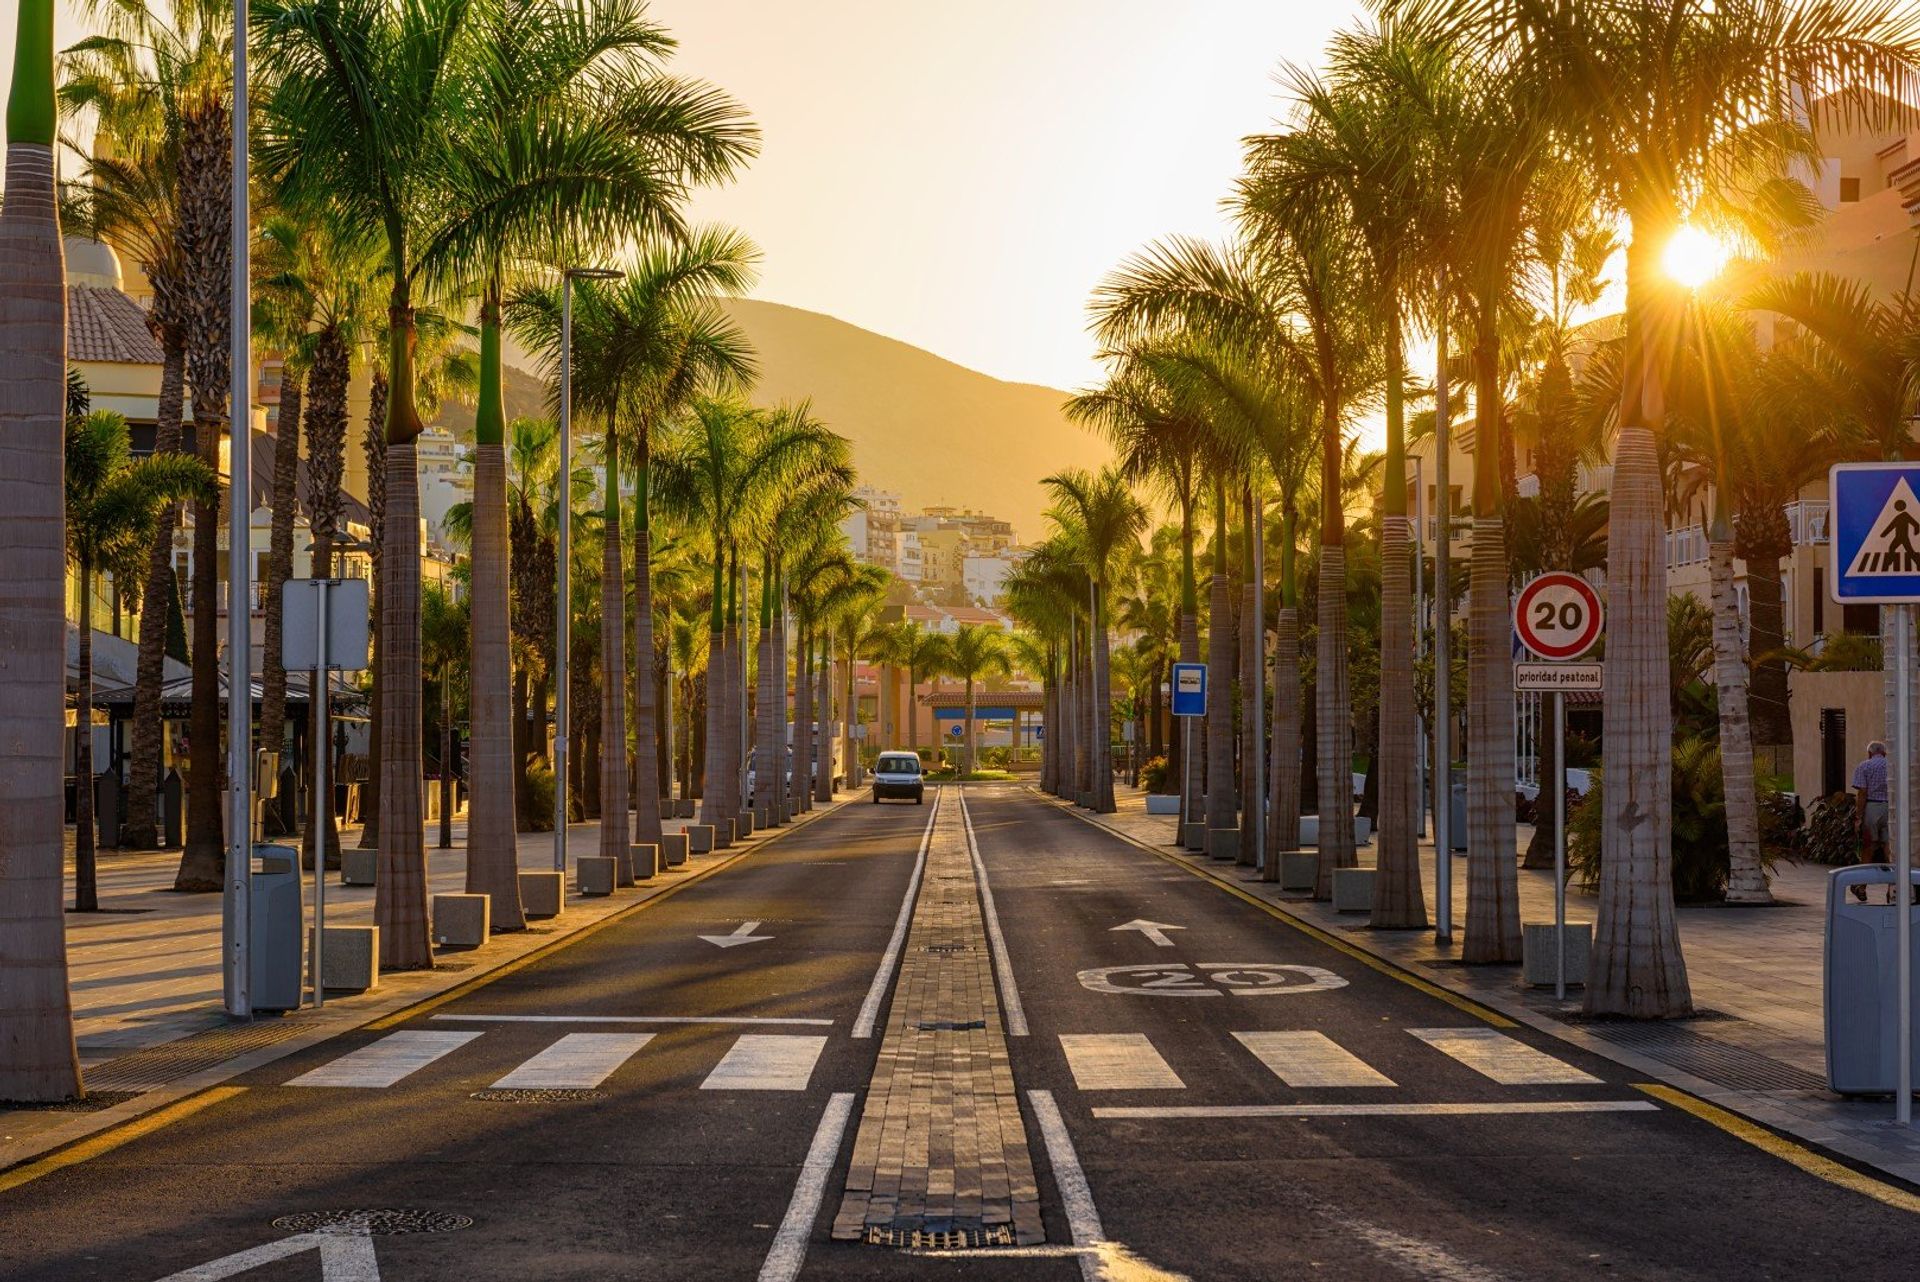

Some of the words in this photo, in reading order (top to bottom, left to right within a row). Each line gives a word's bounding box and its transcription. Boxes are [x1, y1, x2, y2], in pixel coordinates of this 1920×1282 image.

[1534, 602, 1583, 631] 20
[1520, 671, 1557, 684] prioridad
[1560, 671, 1599, 684] peatonal
[1131, 971, 1286, 988] 20
